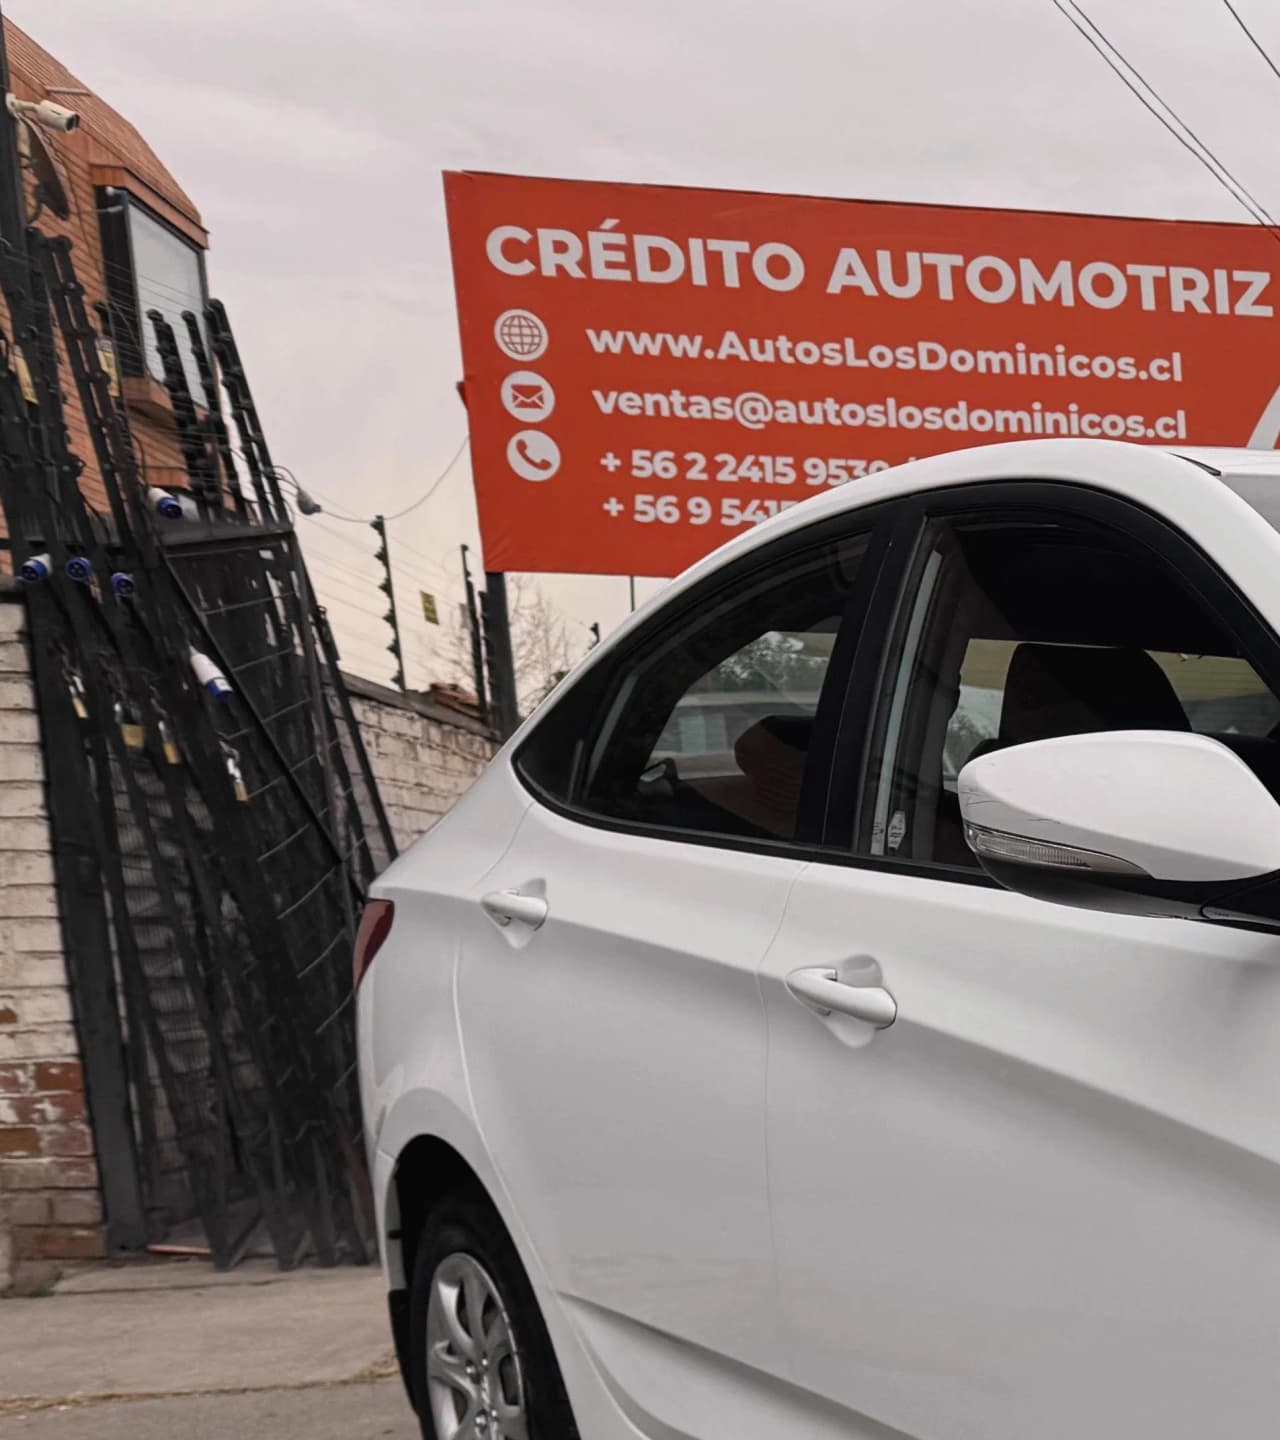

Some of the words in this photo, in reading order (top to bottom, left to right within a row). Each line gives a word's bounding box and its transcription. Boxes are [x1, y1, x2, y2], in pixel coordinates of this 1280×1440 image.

[485, 218, 806, 293] CRÉDITO
[825, 247, 1274, 318] AUTOMOTRIZ
[585, 328, 1184, 382] www.AutosLosDominicos.cl
[591, 388, 1188, 440] ventas@autoslosdominicos.cl
[631, 449, 678, 479] 56
[683, 452, 709, 481] 2
[714, 453, 797, 485] 2415
[633, 494, 681, 524] 56
[686, 495, 712, 526] 9
